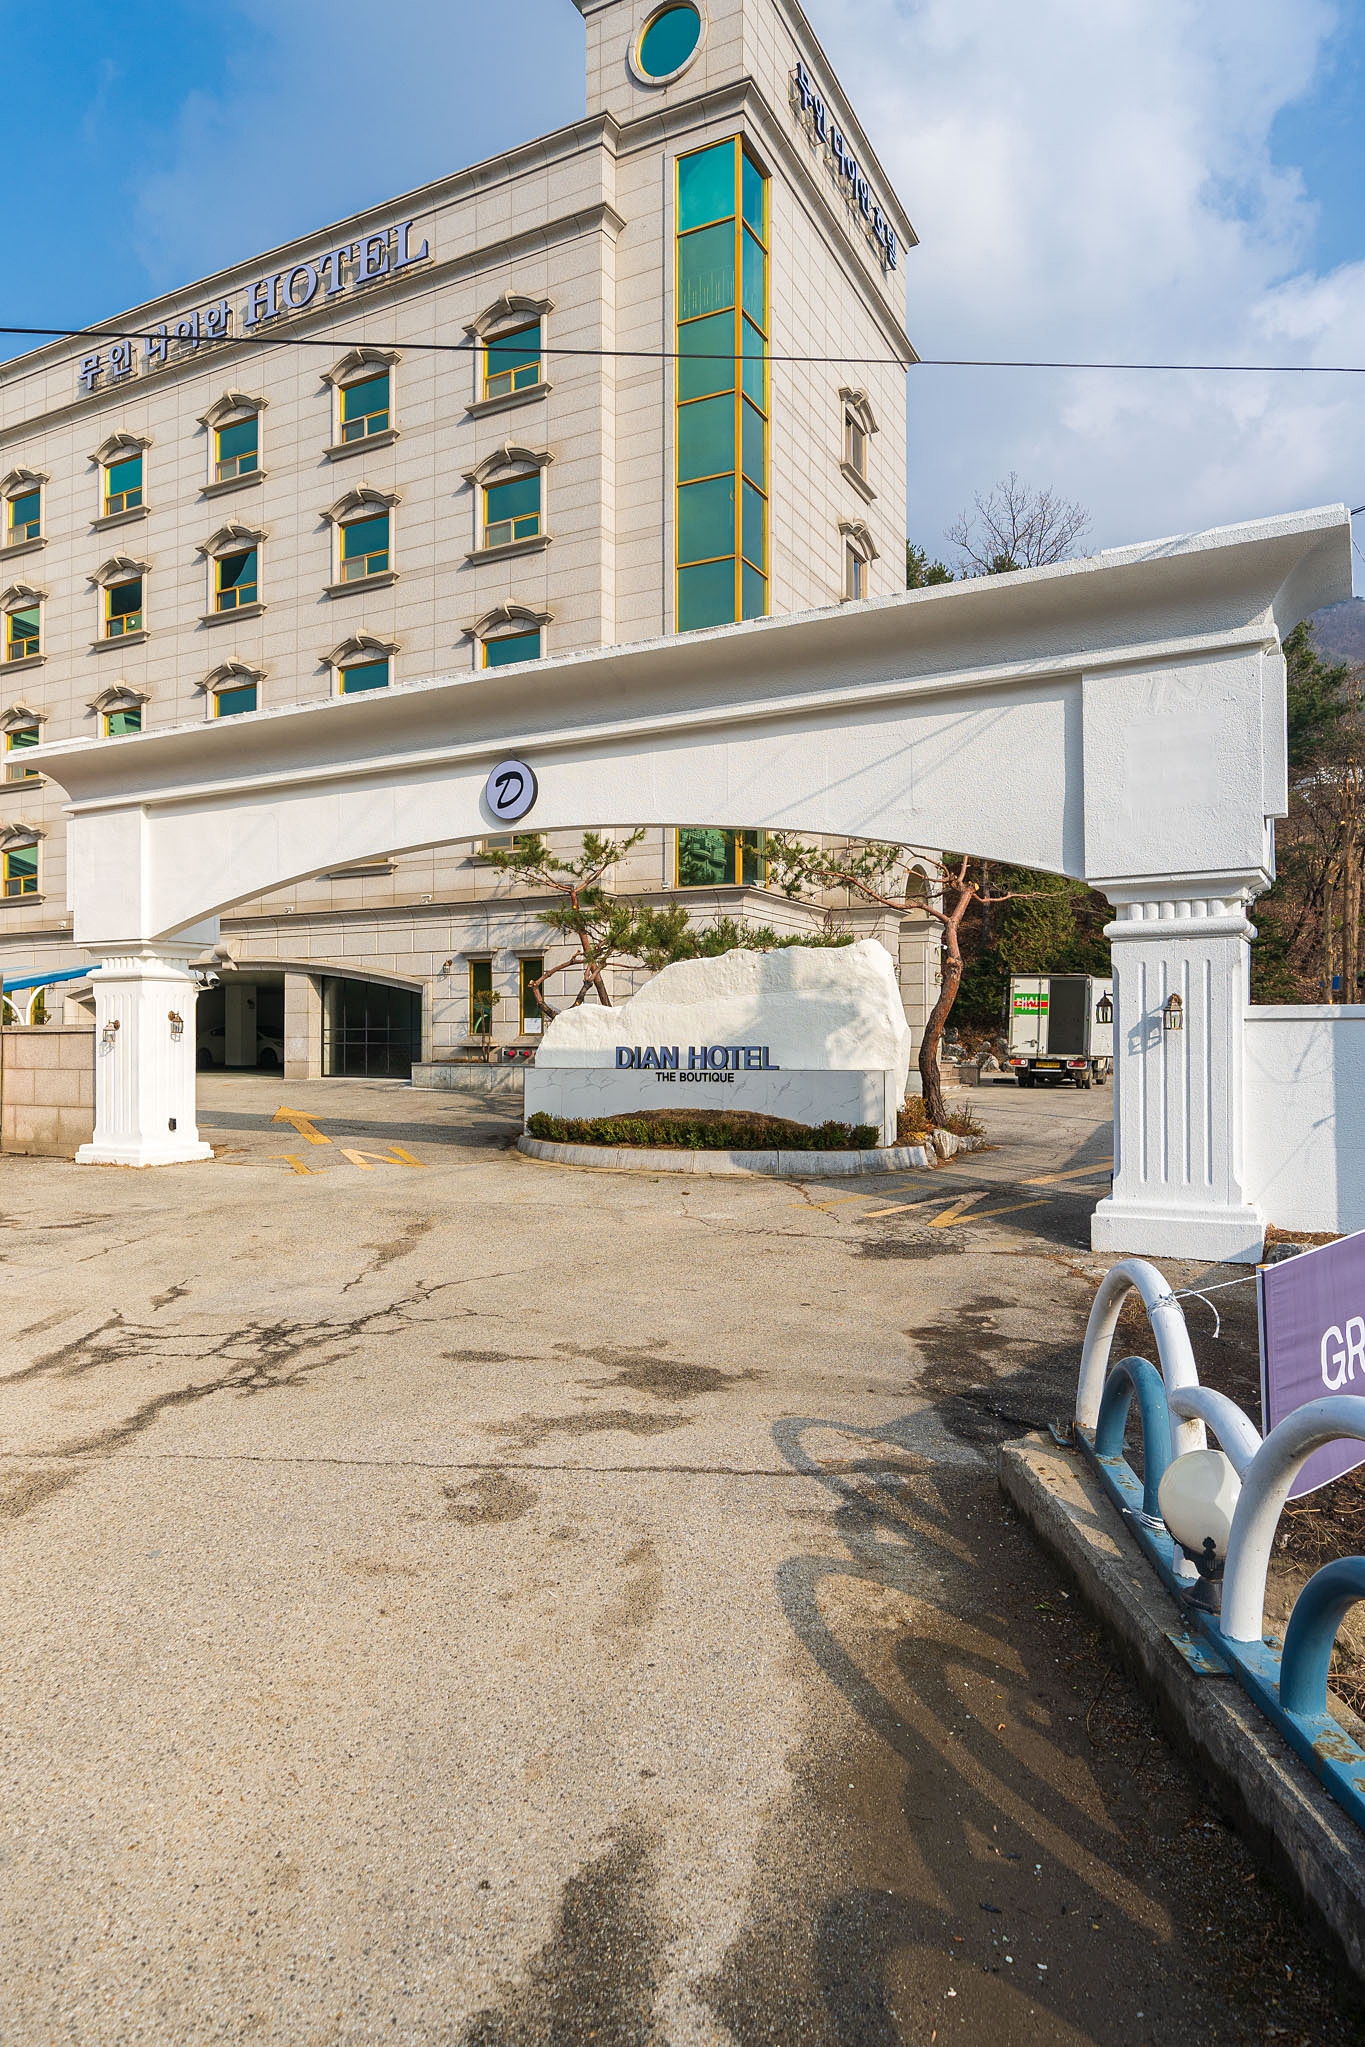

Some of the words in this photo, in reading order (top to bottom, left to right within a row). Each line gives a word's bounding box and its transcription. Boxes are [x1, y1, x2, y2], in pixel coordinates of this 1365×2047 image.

[795, 62, 827, 144] 무인
[830, 125, 872, 222] 다이안
[873, 207, 897, 271] 호텔
[78, 341, 133, 390] 무인
[244, 220, 429, 327] HOTEL
[495, 771, 524, 809] D
[615, 1046, 679, 1070] DIAN
[688, 1045, 780, 1070] HOTEL
[656, 1072, 676, 1082] THE
[680, 1072, 735, 1083] BOUTIQUE
[268, 1146, 429, 1176] IN
